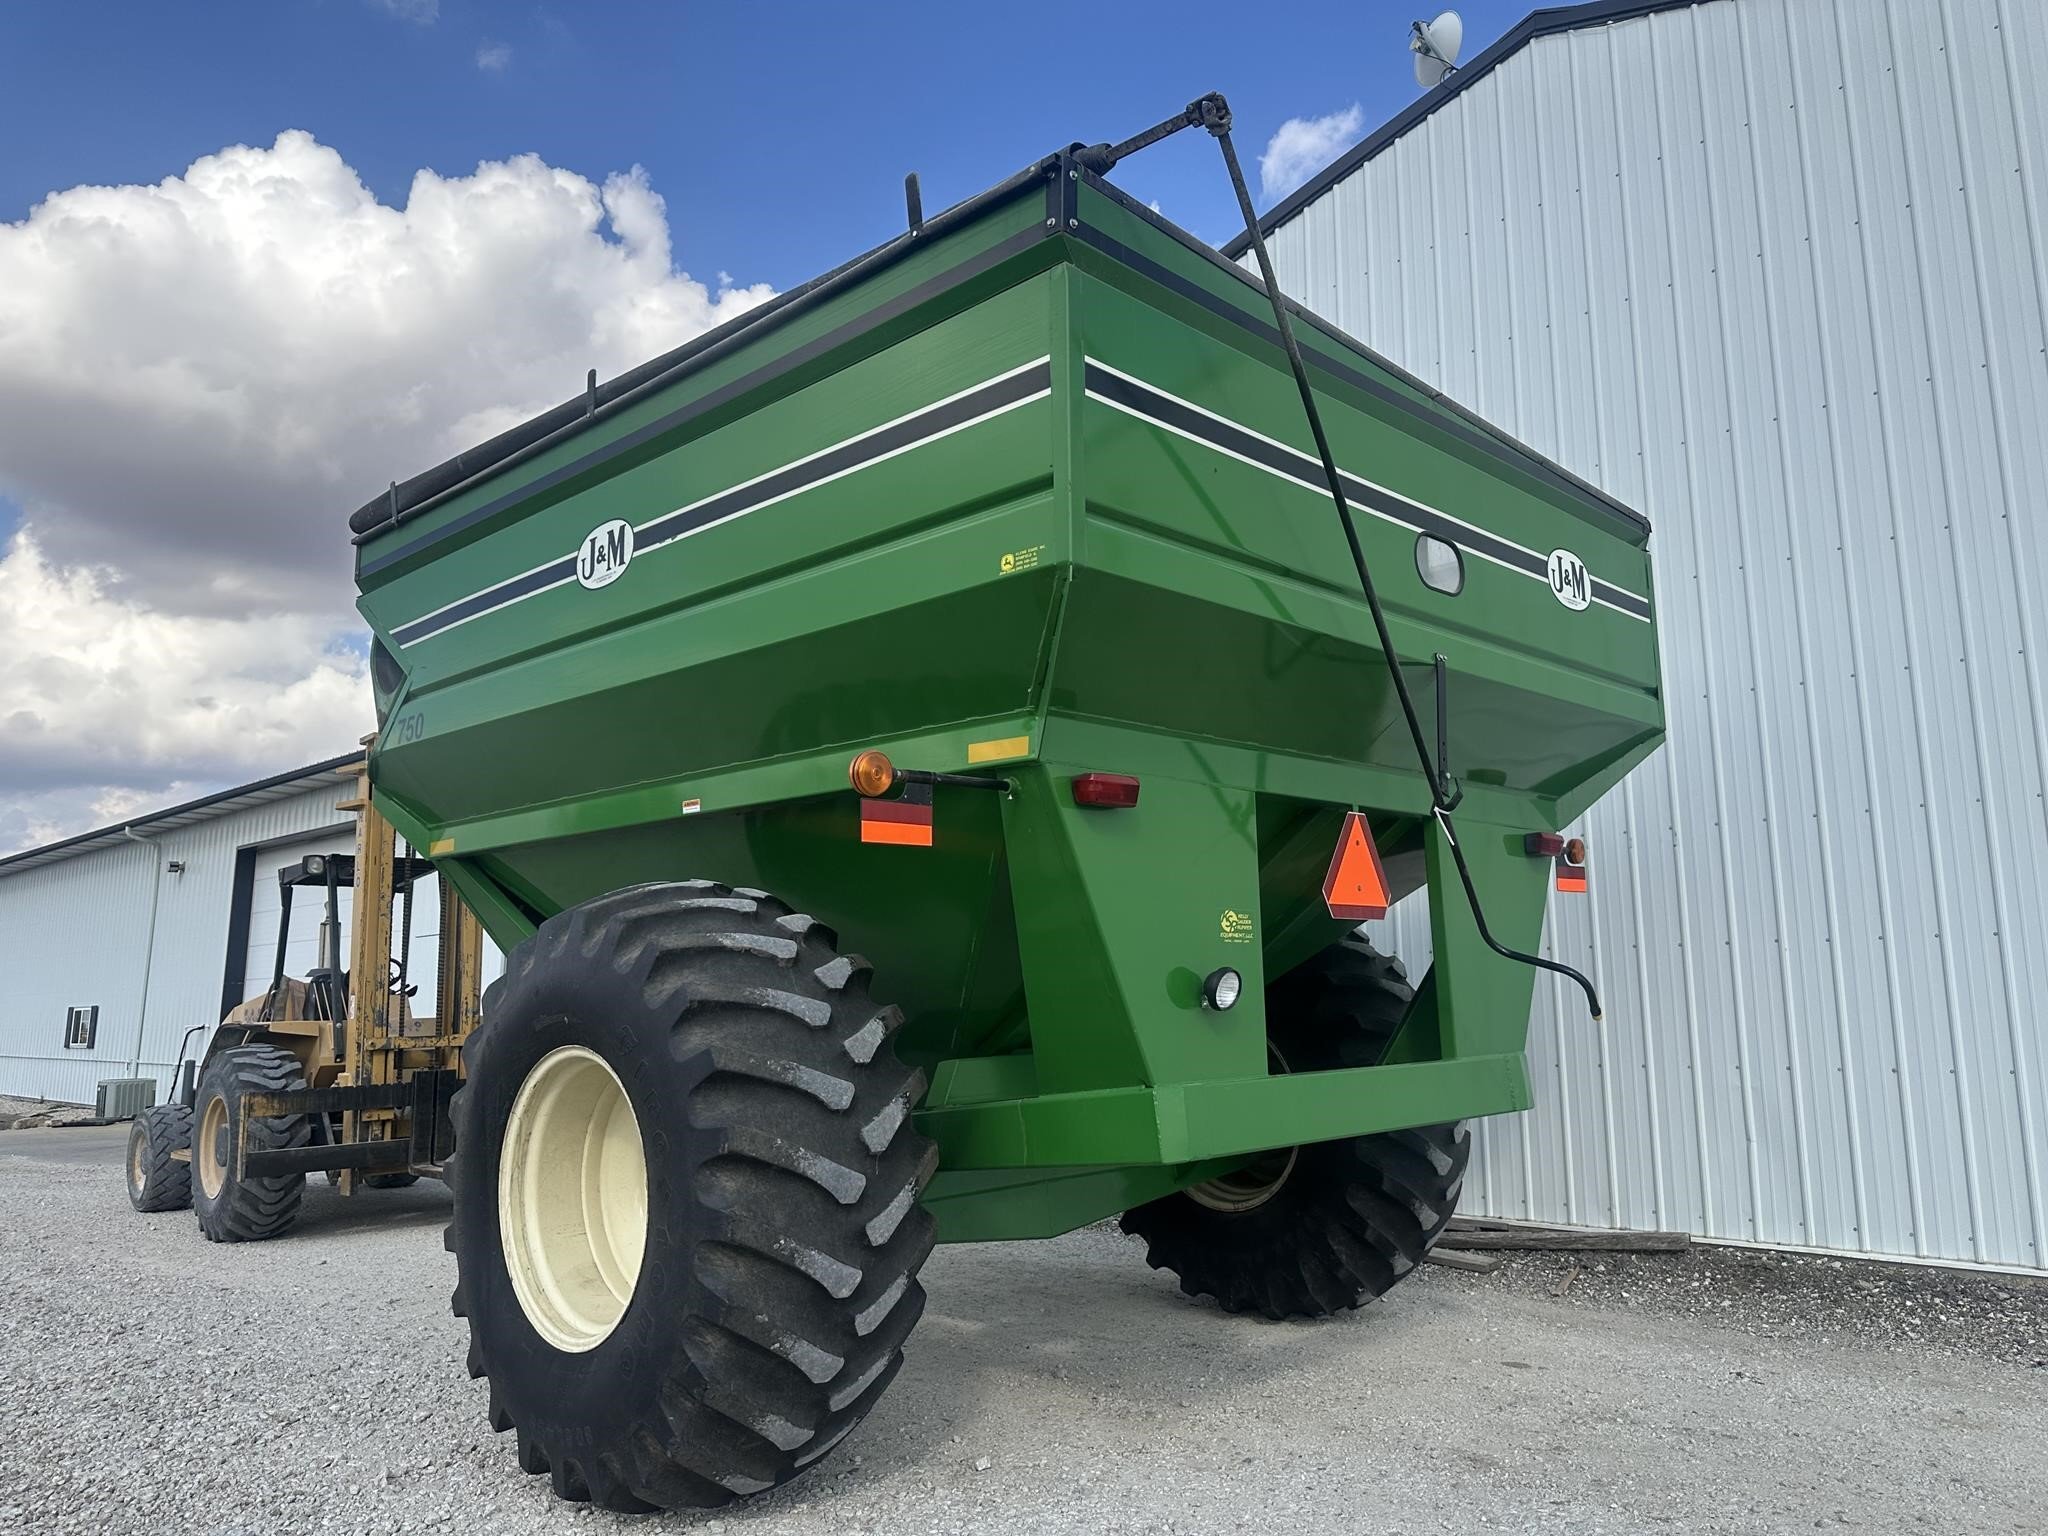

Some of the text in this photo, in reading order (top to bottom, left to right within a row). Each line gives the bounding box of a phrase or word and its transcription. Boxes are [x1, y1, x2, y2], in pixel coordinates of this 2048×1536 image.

[581, 524, 626, 580] J&M
[1551, 555, 1587, 602] J&M
[398, 713, 424, 744] 750
